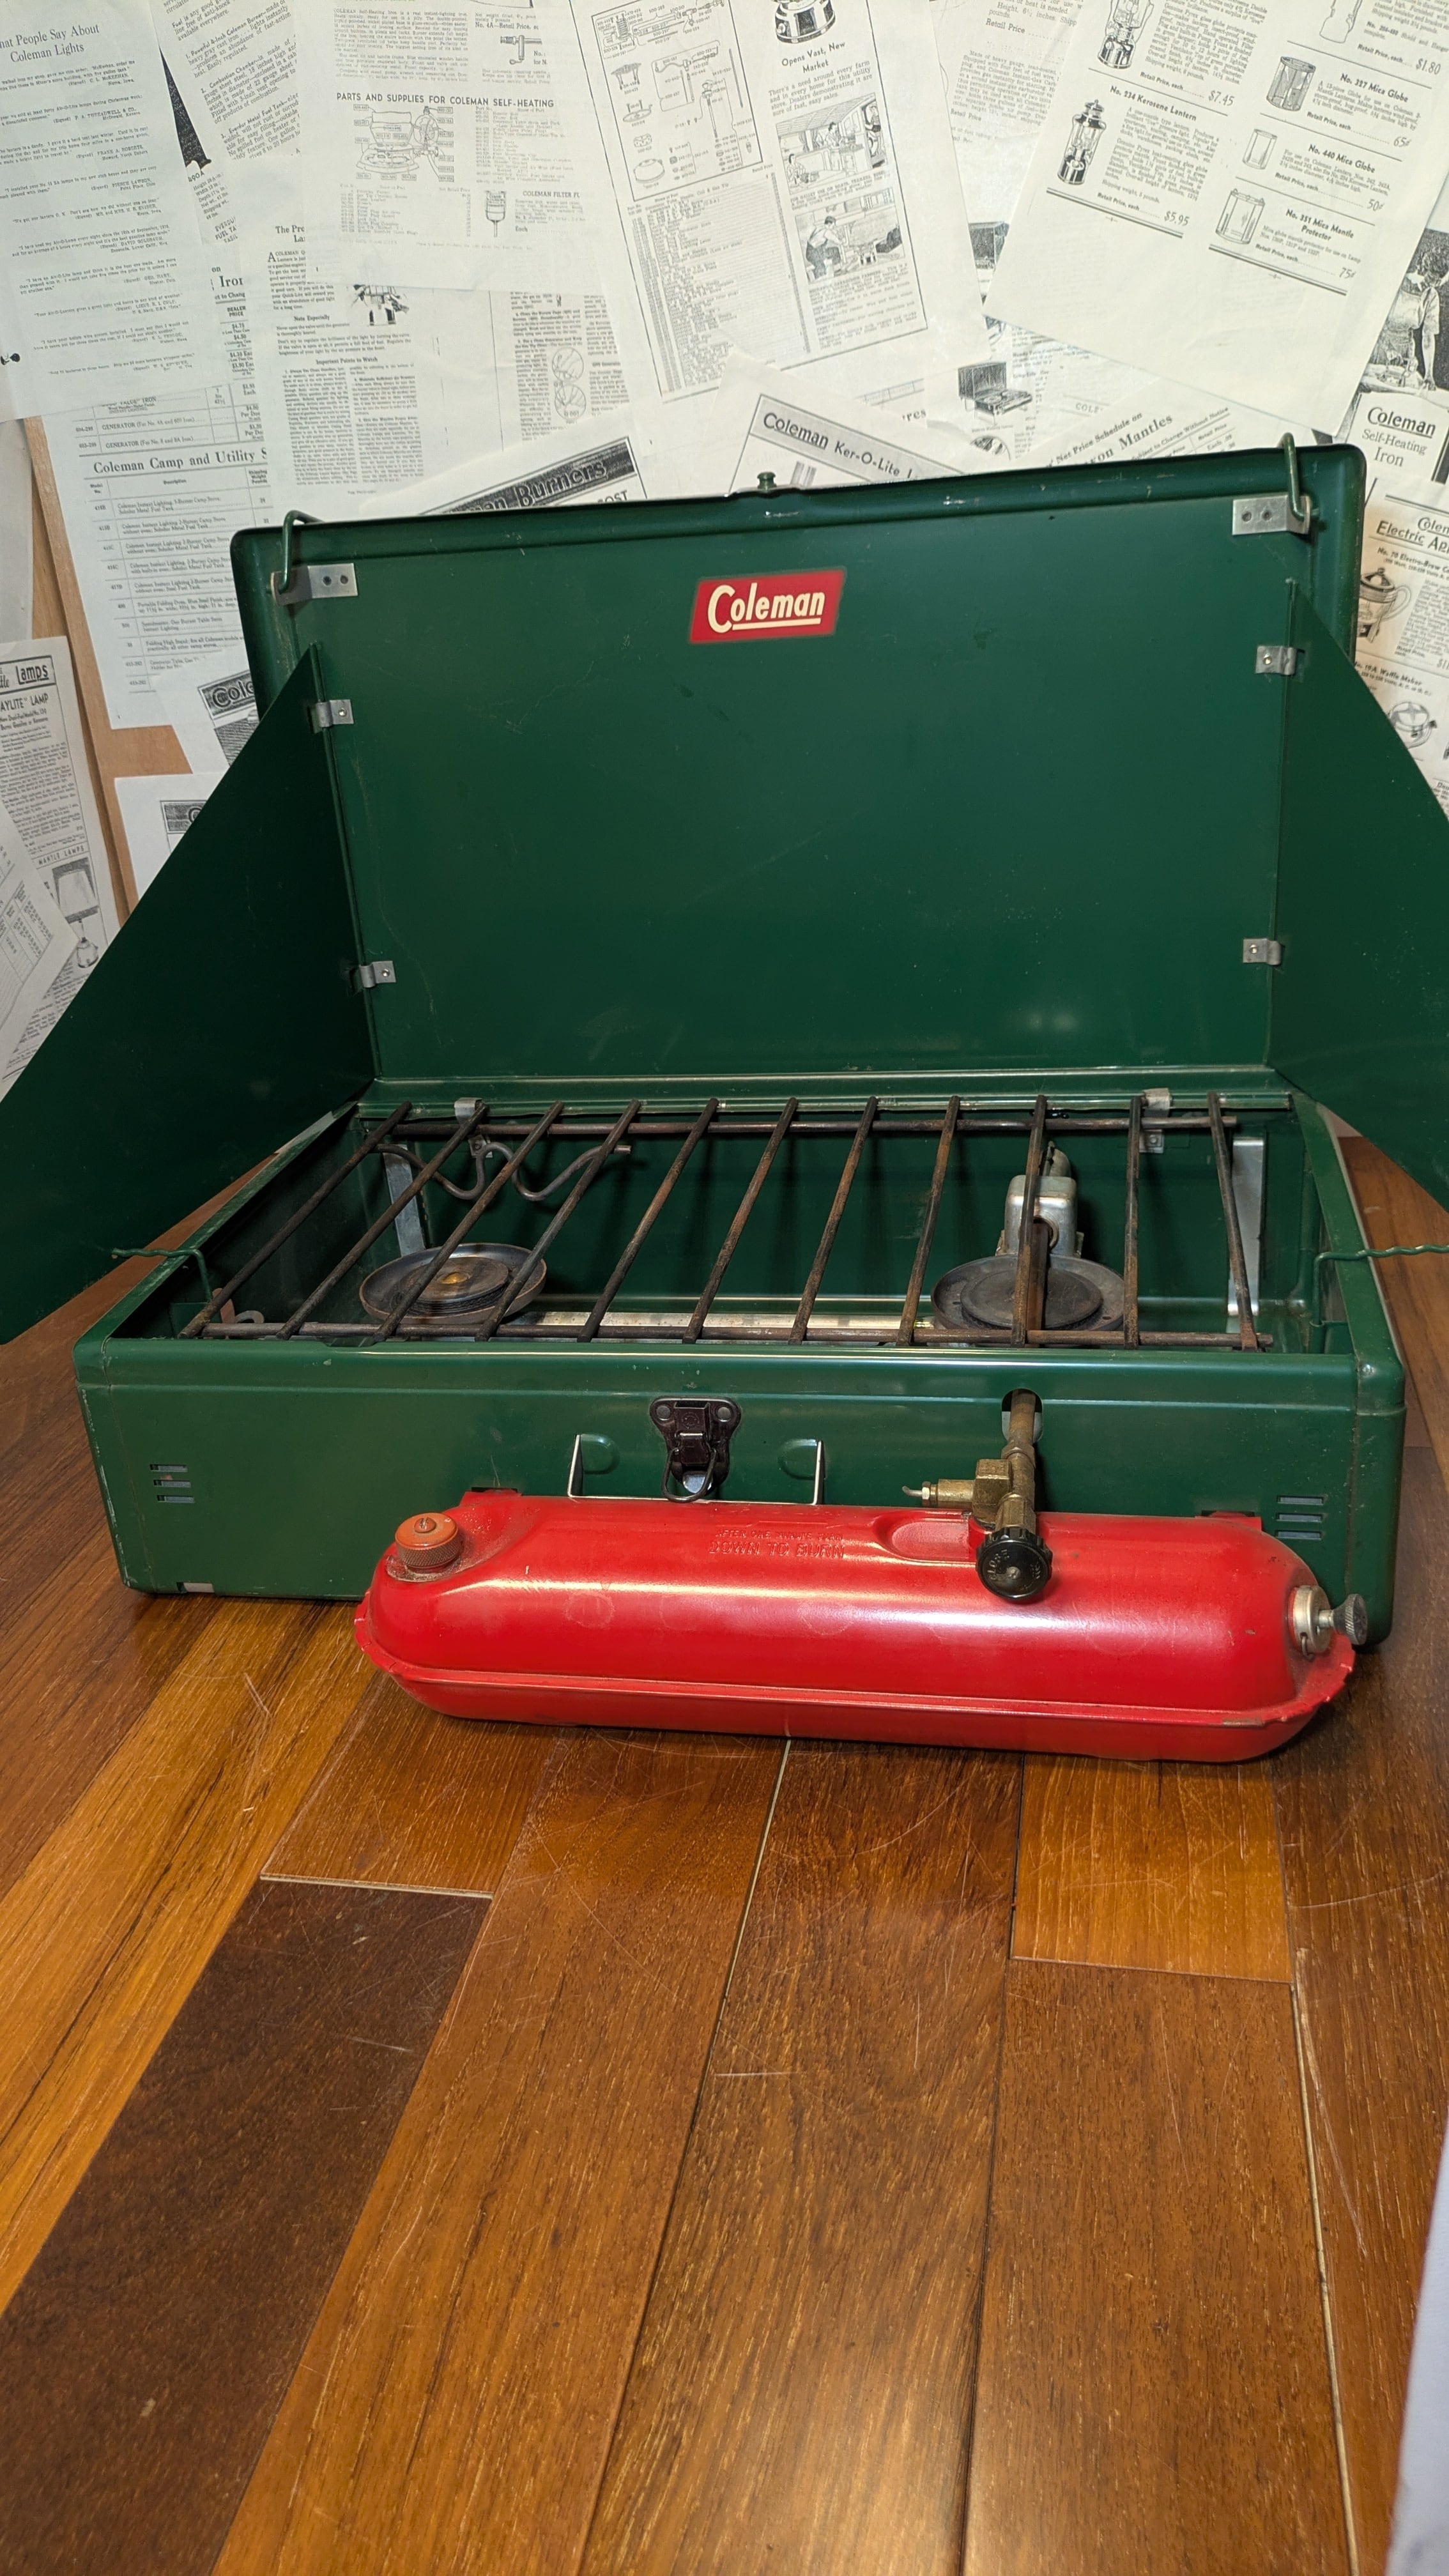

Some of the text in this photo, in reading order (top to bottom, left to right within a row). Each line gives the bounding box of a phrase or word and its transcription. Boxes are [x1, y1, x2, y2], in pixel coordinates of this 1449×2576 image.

[16, 31, 47, 46] People
[50, 29, 66, 40] Say
[72, 24, 100, 37] About
[178, 27, 199, 41] available
[986, 18, 1025, 34] Retail Price
[192, 42, 210, 56] Powerful
[227, 22, 247, 36] Coleman
[11, 43, 84, 62] Coleman Lights
[781, 42, 845, 67] Opens Vast, New
[798, 79, 811, 88] need
[813, 72, 834, 82] around
[837, 65, 852, 75] every
[855, 60, 870, 68] farm
[802, 60, 829, 73] Market
[1140, 72, 1155, 80] Retail
[1416, 57, 1441, 75] $1.80
[210, 72, 235, 88] Combustion
[791, 88, 806, 98] every
[809, 81, 824, 91] home
[853, 67, 871, 78] utility
[1340, 73, 1408, 103] No. 327 Mica Globe
[337, 93, 361, 101] PARTS
[387, 94, 424, 103] SUPPLIES
[450, 96, 489, 105] COLEMAN
[493, 98, 554, 107] SELF-HEATING
[790, 94, 811, 105] Dealers
[1110, 86, 1197, 121] No. 234 Kerosene Lantern
[1209, 90, 1234, 107] $7.45
[1307, 112, 1322, 122] Retail
[1308, 144, 1376, 173] No. 440 Mica Globe
[1275, 172, 1291, 182] Retail
[1097, 192, 1112, 203] Retail
[1164, 210, 1190, 226] $5.95
[1285, 209, 1354, 238] No. 351 Mica Mantle
[1301, 225, 1331, 241] Protector
[1255, 244, 1271, 253] Retail
[1367, 407, 1436, 437] Coleman
[1073, 440, 1093, 453] Price
[1095, 420, 1130, 442] Schedule
[1131, 413, 1142, 422] on
[1119, 415, 1173, 450] Mantles
[1362, 429, 1427, 456] Self-Heating
[763, 412, 900, 477] Coleman Ker-O-Lite
[93, 450, 256, 474] Coleman Camp and Utility
[1374, 447, 1404, 467] Iron
[514, 461, 608, 509] Burners
[1376, 520, 1425, 544] Electric
[708, 582, 825, 633] Coleman
[15, 664, 49, 685] Lamps
[30, 693, 49, 706] LAMP
[709, 1541, 845, 1558] DOWN TO BURN
